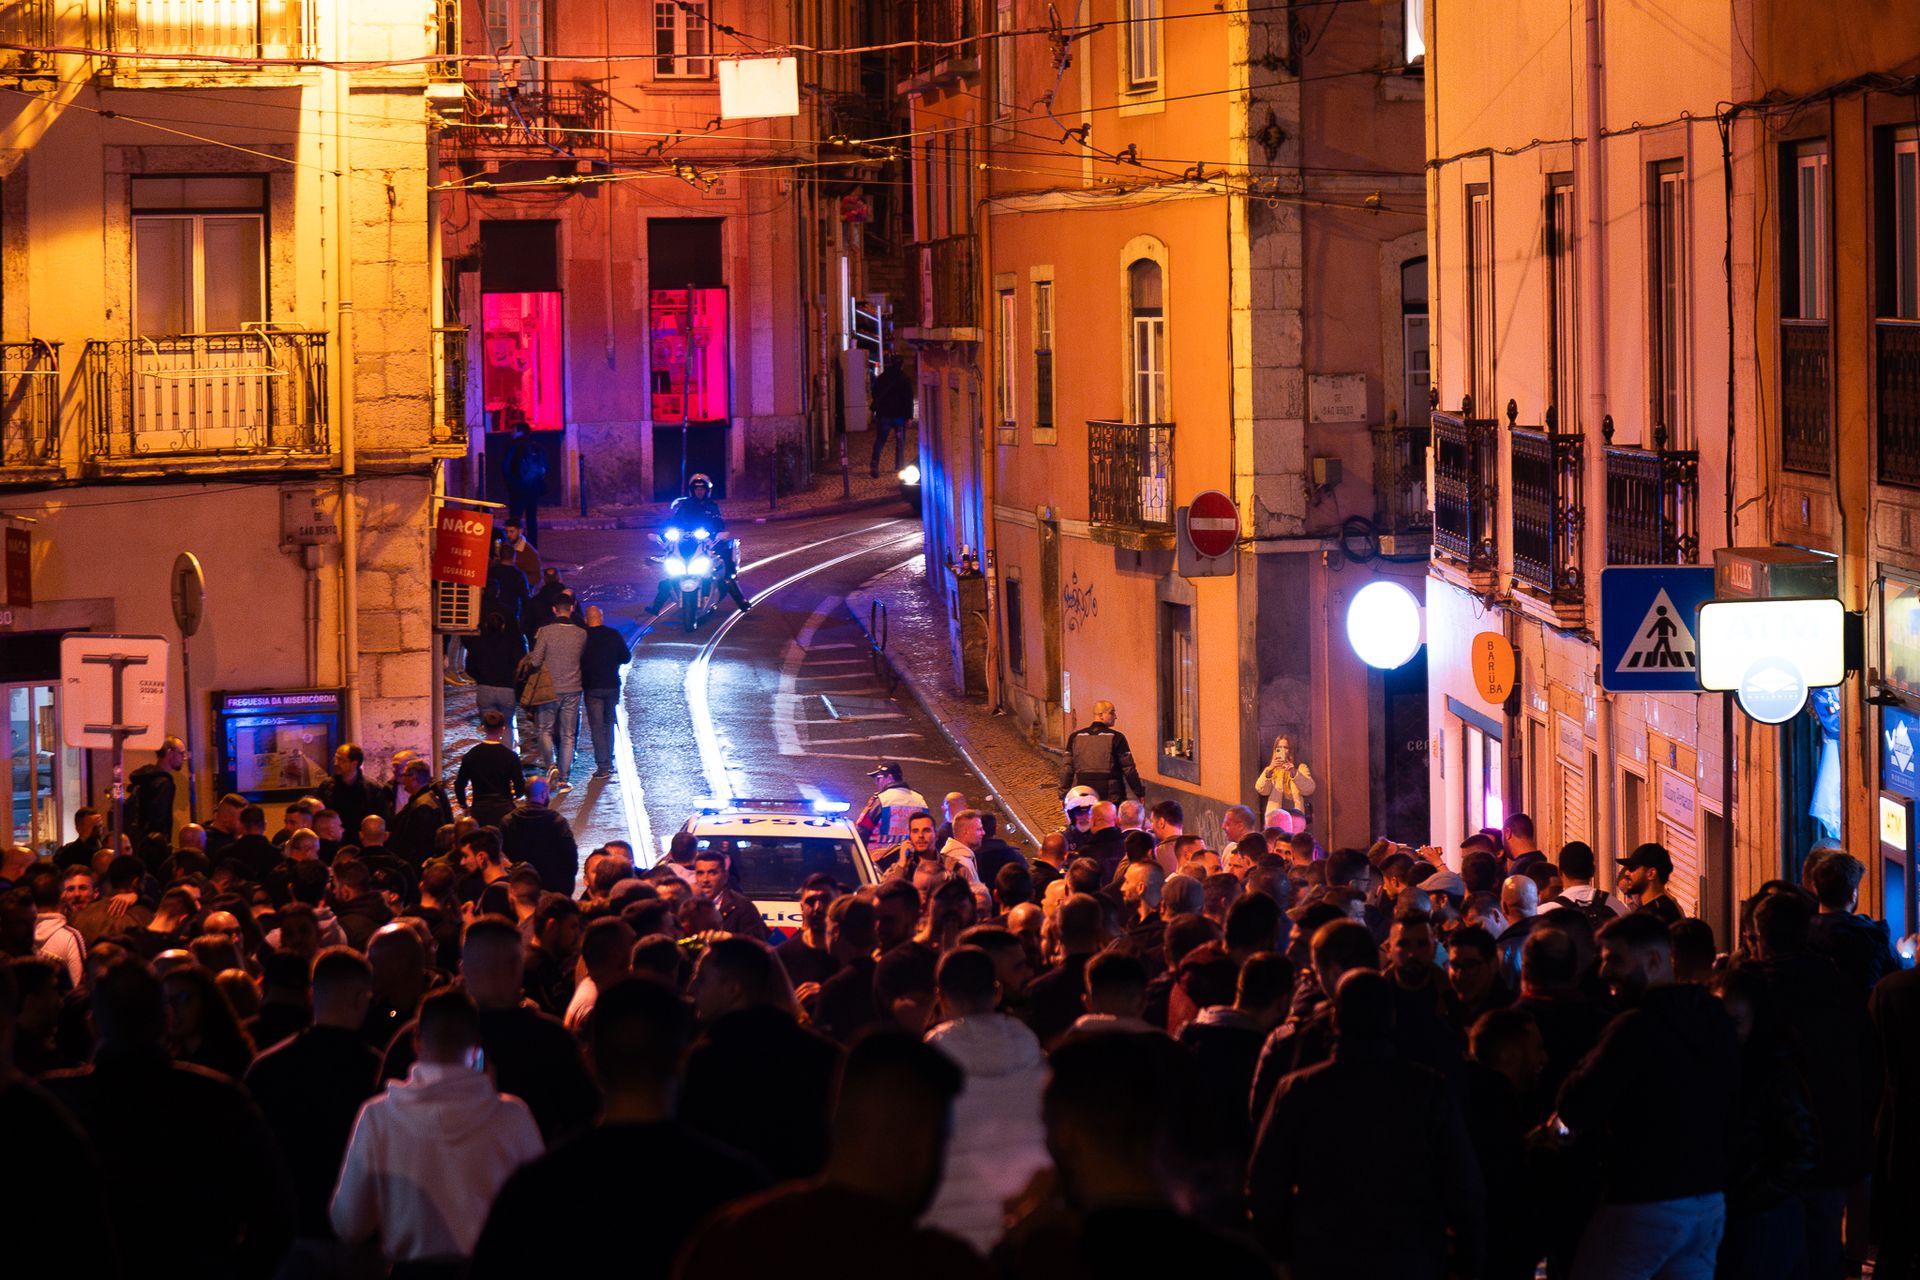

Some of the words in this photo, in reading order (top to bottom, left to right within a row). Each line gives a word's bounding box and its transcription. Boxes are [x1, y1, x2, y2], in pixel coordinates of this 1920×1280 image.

[442, 517, 485, 536] NACO
[227, 697, 270, 707] FREGUESIA
[271, 697, 282, 705] DA
